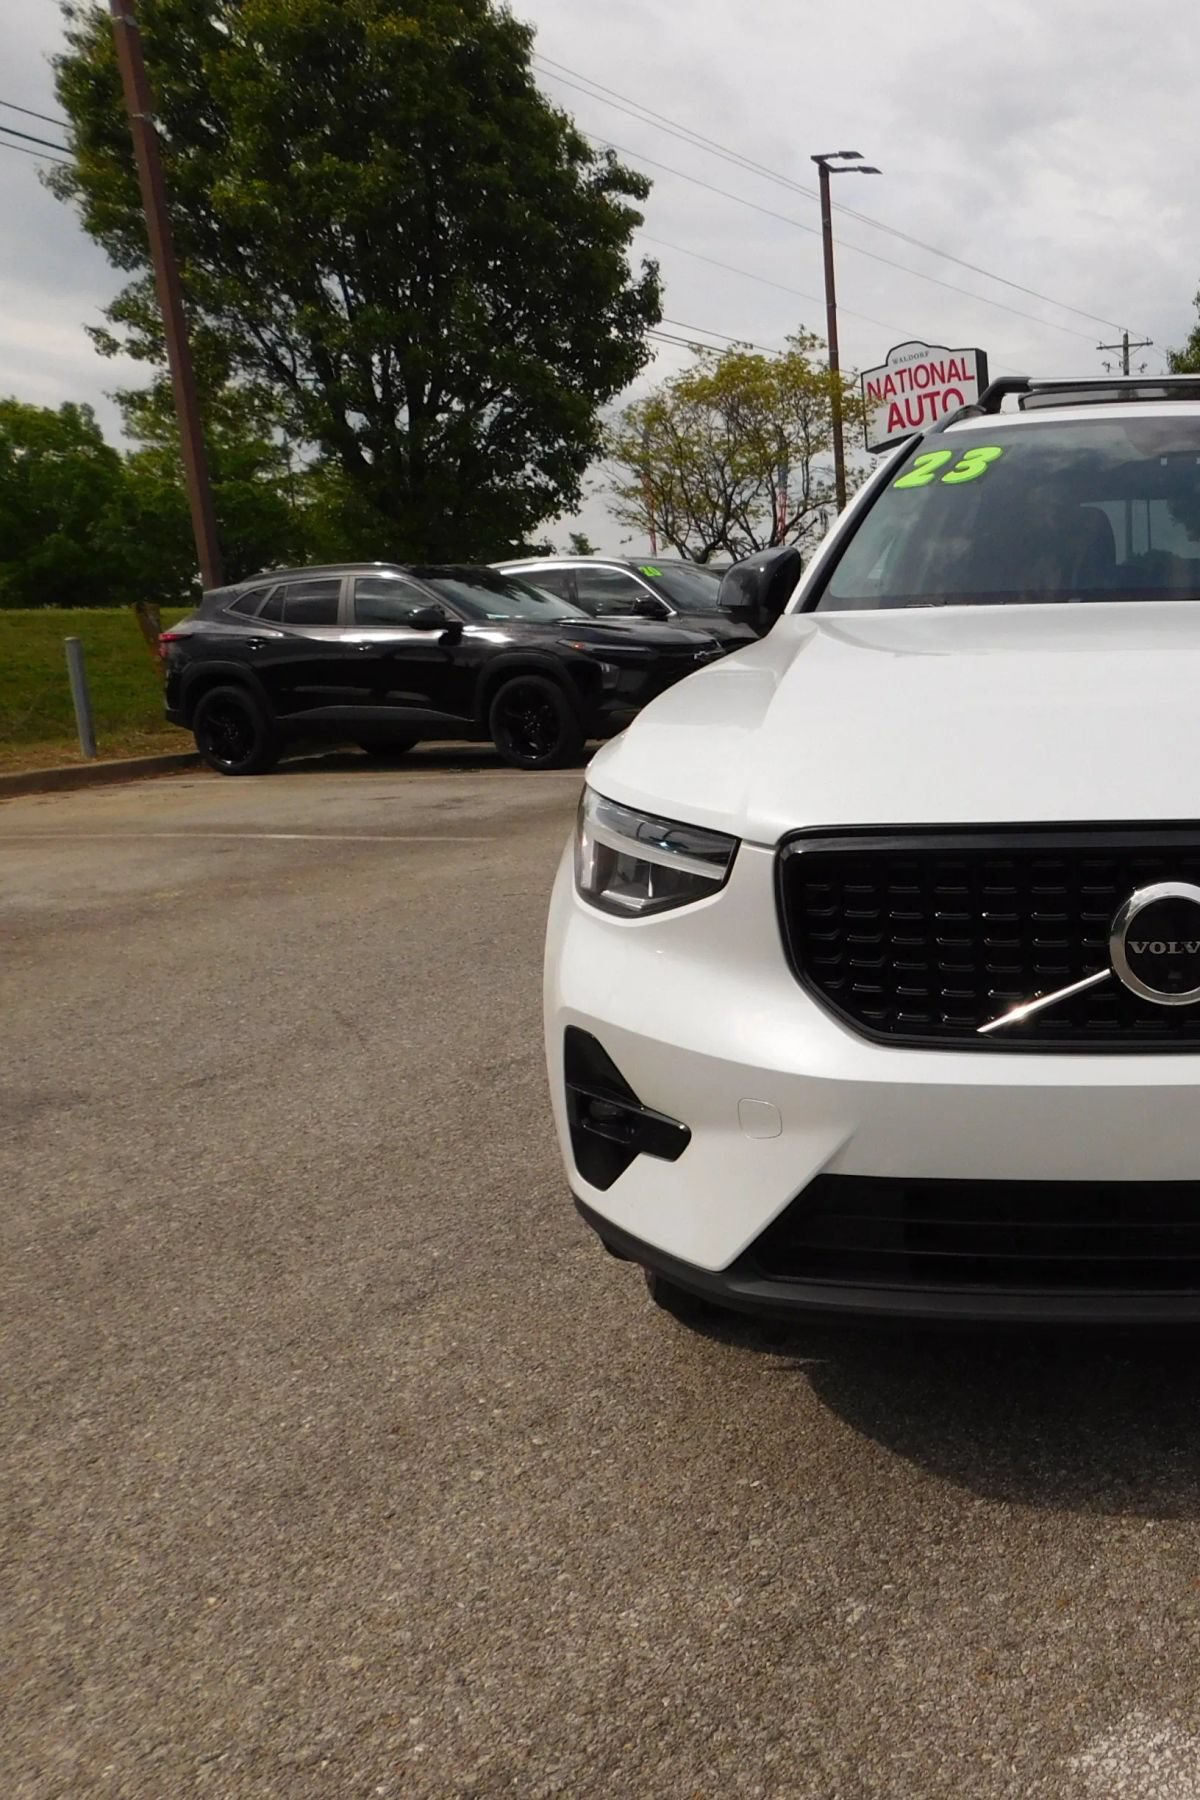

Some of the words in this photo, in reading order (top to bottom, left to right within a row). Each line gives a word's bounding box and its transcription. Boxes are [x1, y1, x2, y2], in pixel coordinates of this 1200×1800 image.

[892, 351, 929, 364] WALDORF
[867, 358, 975, 401] NATIONAL
[887, 388, 965, 433] AUTO
[893, 447, 1003, 488] 23
